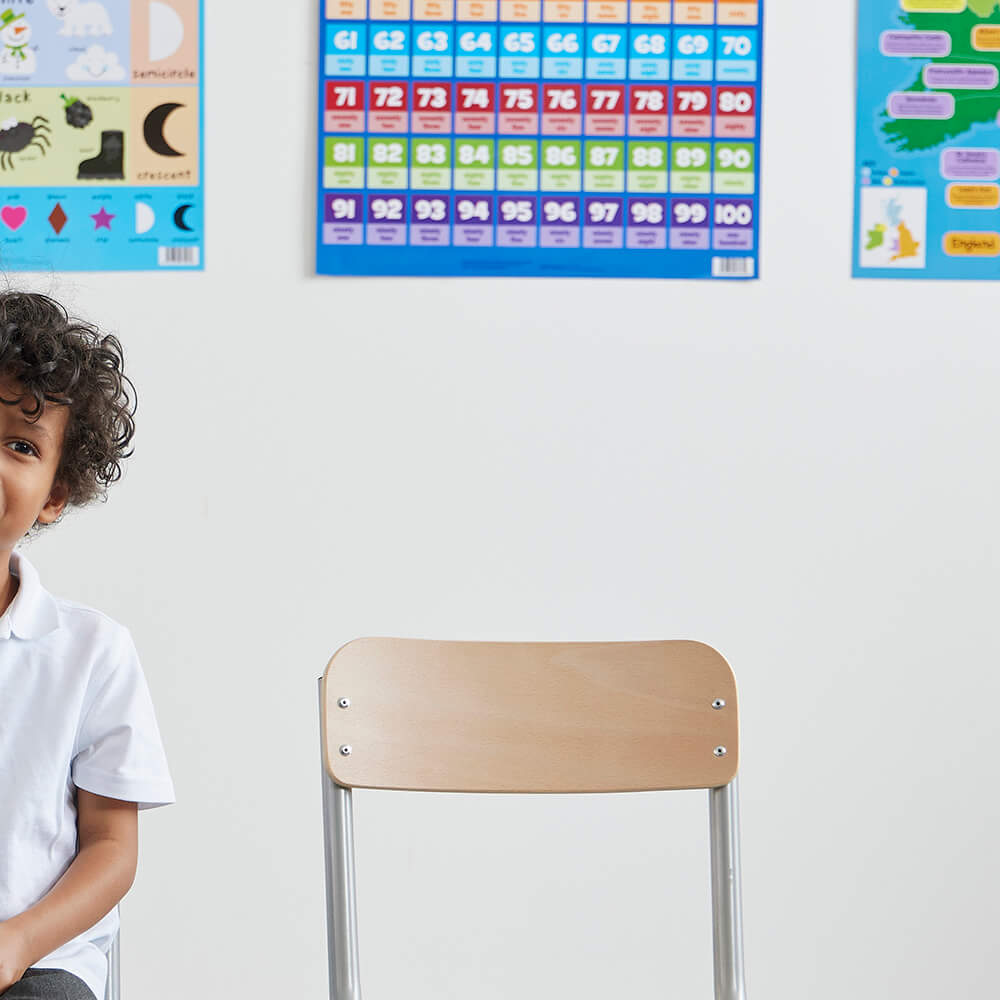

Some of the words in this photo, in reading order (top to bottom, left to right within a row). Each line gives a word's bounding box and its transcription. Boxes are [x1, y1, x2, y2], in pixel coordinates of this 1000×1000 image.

[334, 30, 357, 50] 61
[374, 30, 404, 50] 62
[417, 31, 448, 51] 63
[460, 32, 492, 51] 64
[504, 32, 534, 52] 65
[547, 34, 578, 53] 66
[592, 34, 620, 53] 67
[634, 34, 665, 54] 68
[678, 35, 708, 54] 69
[722, 36, 751, 56] 70
[133, 68, 196, 79] semicircle
[334, 87, 356, 106] 71
[374, 86, 403, 106] 72
[418, 88, 446, 108] 73
[462, 88, 489, 108] 74
[504, 89, 533, 109] 75
[548, 90, 576, 109] 76
[592, 90, 620, 109] 77
[634, 91, 663, 110] 78
[678, 91, 707, 110] 79
[720, 92, 752, 112] 80
[334, 143, 356, 162] 81
[374, 143, 403, 163] 82
[416, 144, 446, 164] 83
[459, 145, 490, 164] 84
[503, 146, 533, 165] 85
[546, 146, 576, 166] 86
[590, 146, 619, 166] 87
[632, 147, 662, 166] 88
[676, 148, 706, 167] 89
[718, 147, 750, 168] 90
[137, 170, 191, 180] crescent
[332, 199, 355, 218] 91
[372, 199, 402, 219] 92
[415, 200, 445, 220] 93
[458, 200, 489, 220] 94
[502, 201, 532, 222] 95
[544, 202, 576, 222] 96
[589, 202, 618, 222] 97
[632, 203, 662, 223] 98
[674, 204, 706, 223] 99
[715, 204, 752, 224] 100
